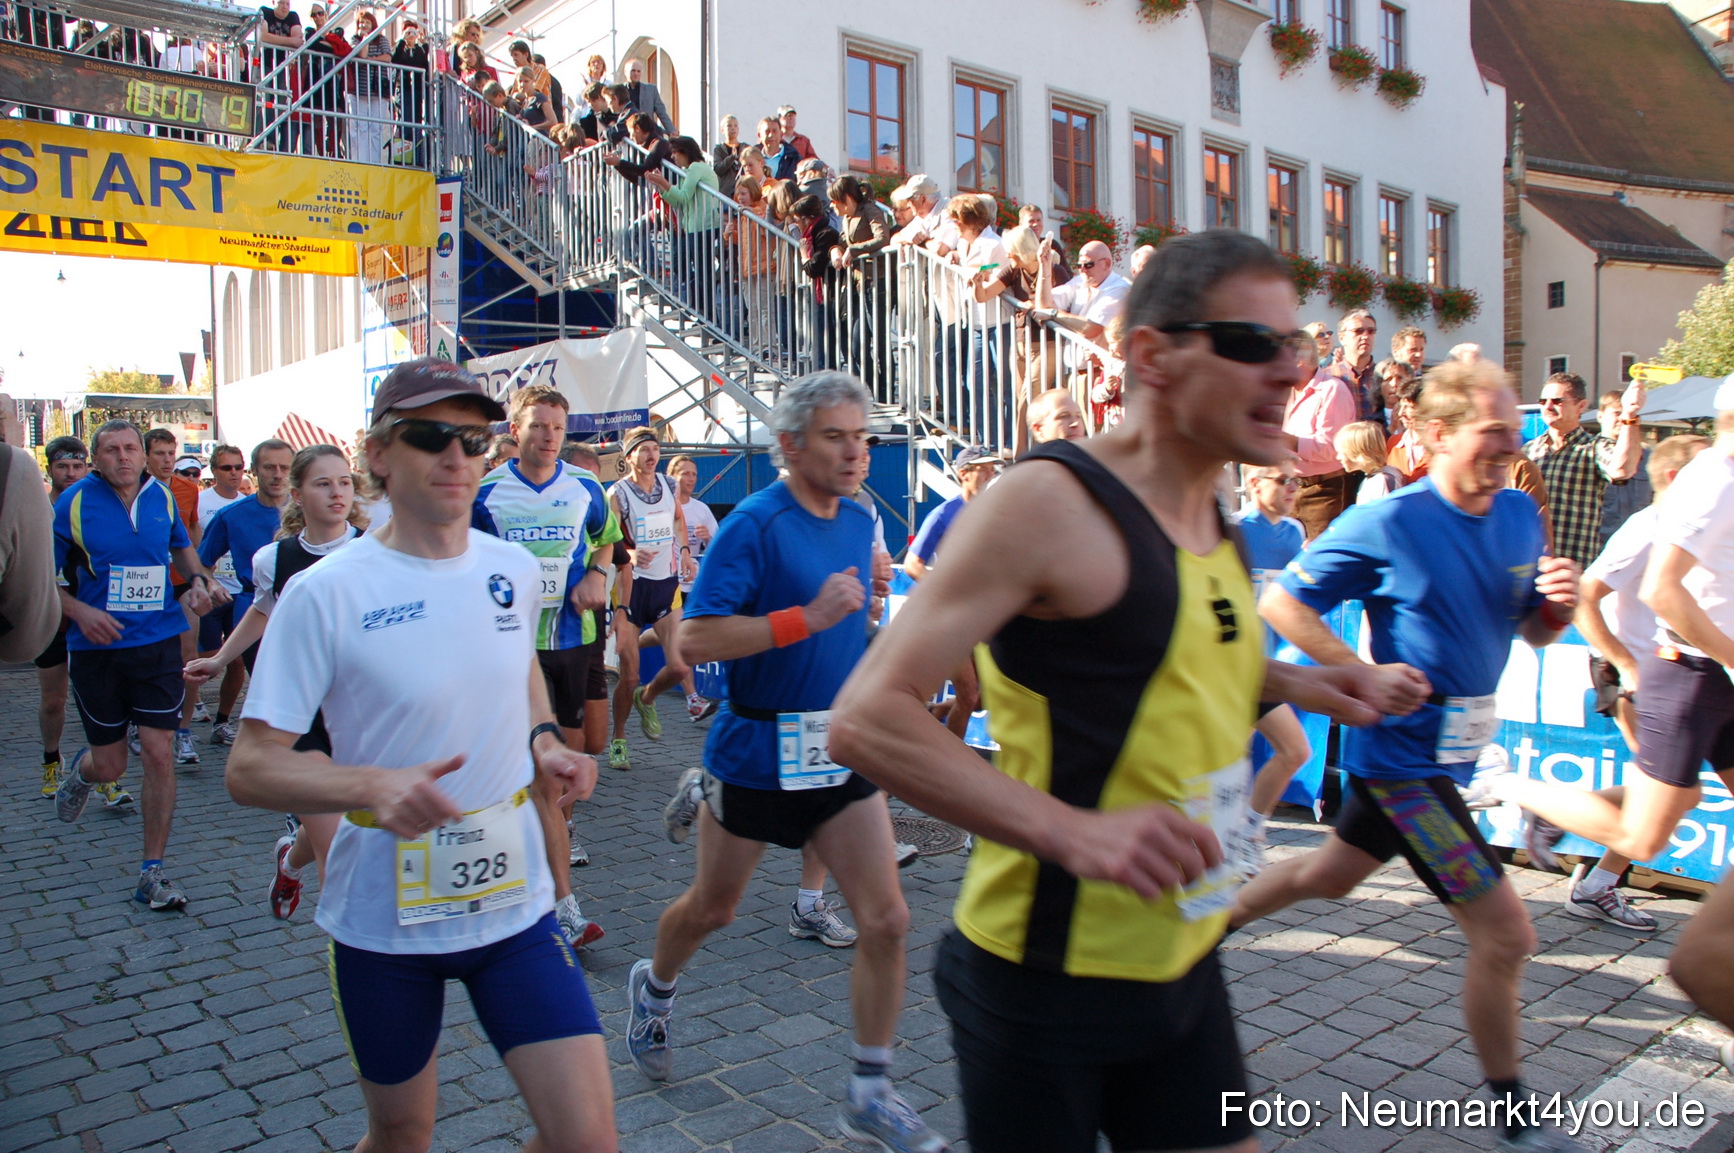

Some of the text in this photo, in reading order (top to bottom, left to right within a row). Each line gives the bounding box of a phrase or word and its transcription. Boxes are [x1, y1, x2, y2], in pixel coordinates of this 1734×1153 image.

[84, 60, 245, 95] Elektronische Sportstätteneinrichtungen
[0, 138, 236, 213] START
[277, 199, 403, 221] Neumarkter Stadtlauf
[219, 236, 331, 254] Neumarkter Stadtlauf
[505, 525, 576, 542] BOCK
[647, 526, 671, 539] 3568
[126, 570, 149, 580] Alfred
[126, 585, 162, 599] 3427
[451, 852, 507, 889] 328
